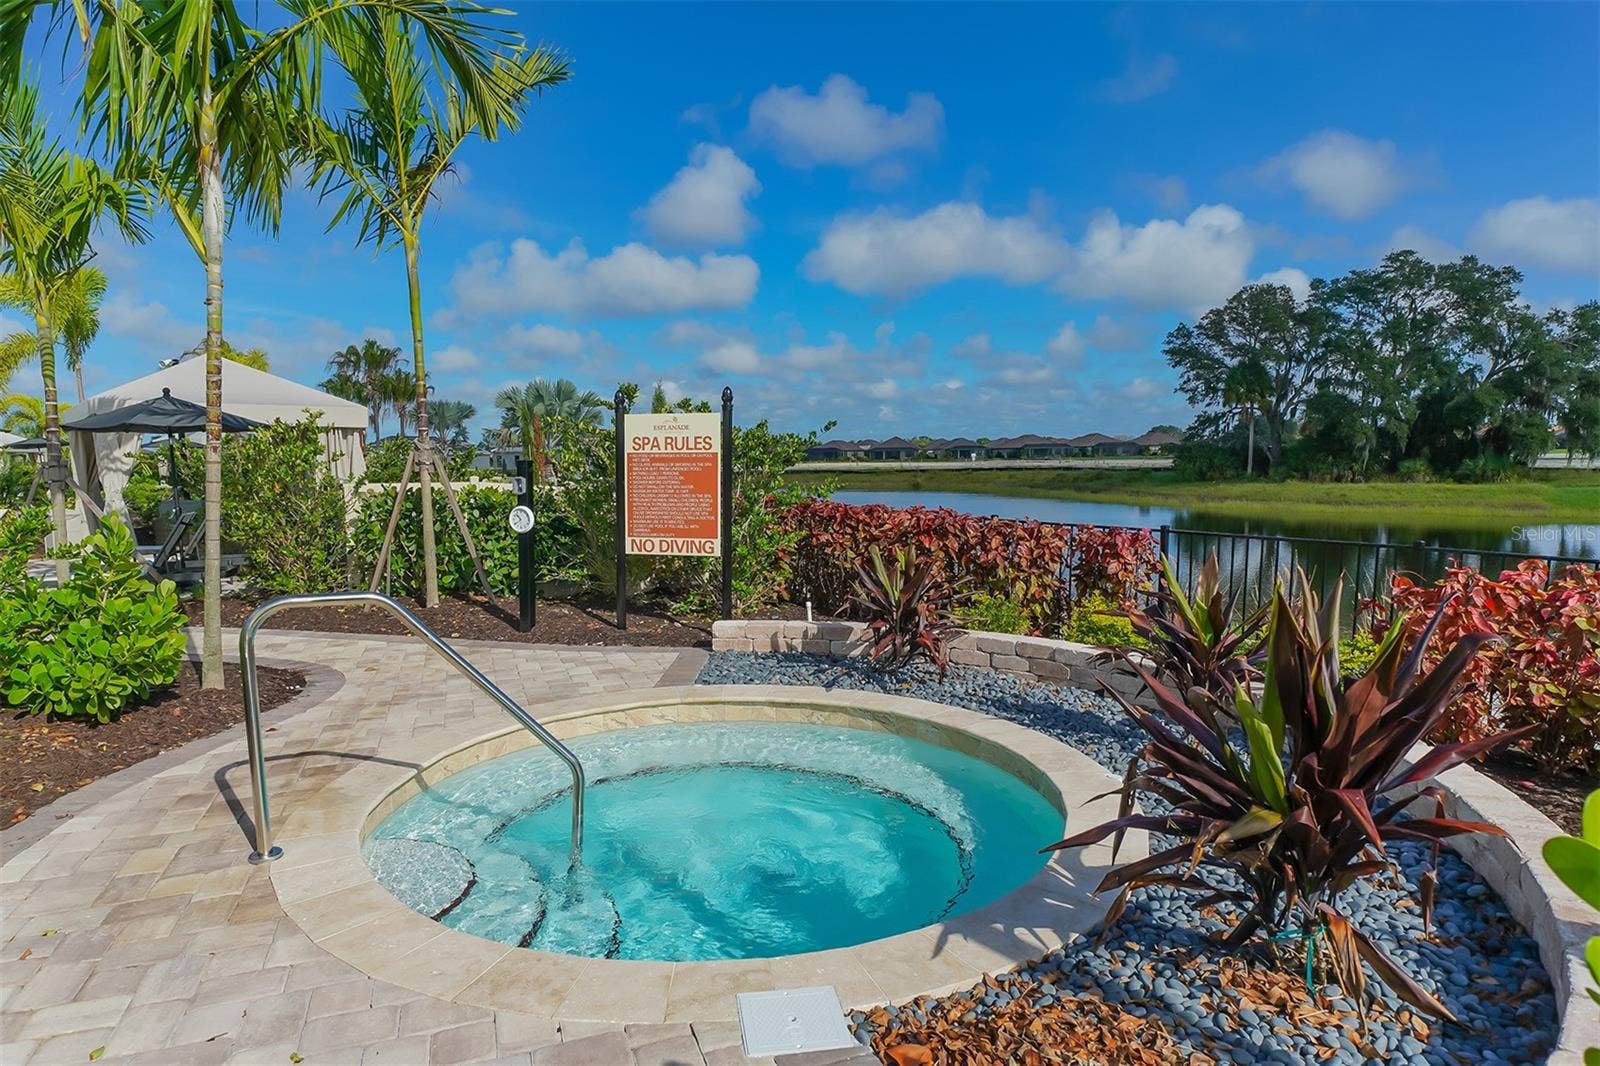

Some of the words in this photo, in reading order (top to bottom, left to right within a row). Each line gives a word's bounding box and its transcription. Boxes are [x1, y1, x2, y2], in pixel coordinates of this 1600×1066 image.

[632, 436, 661, 451] SPA
[664, 436, 712, 451] RULES
[631, 539, 655, 553] NO
[659, 540, 715, 554] DIVING
